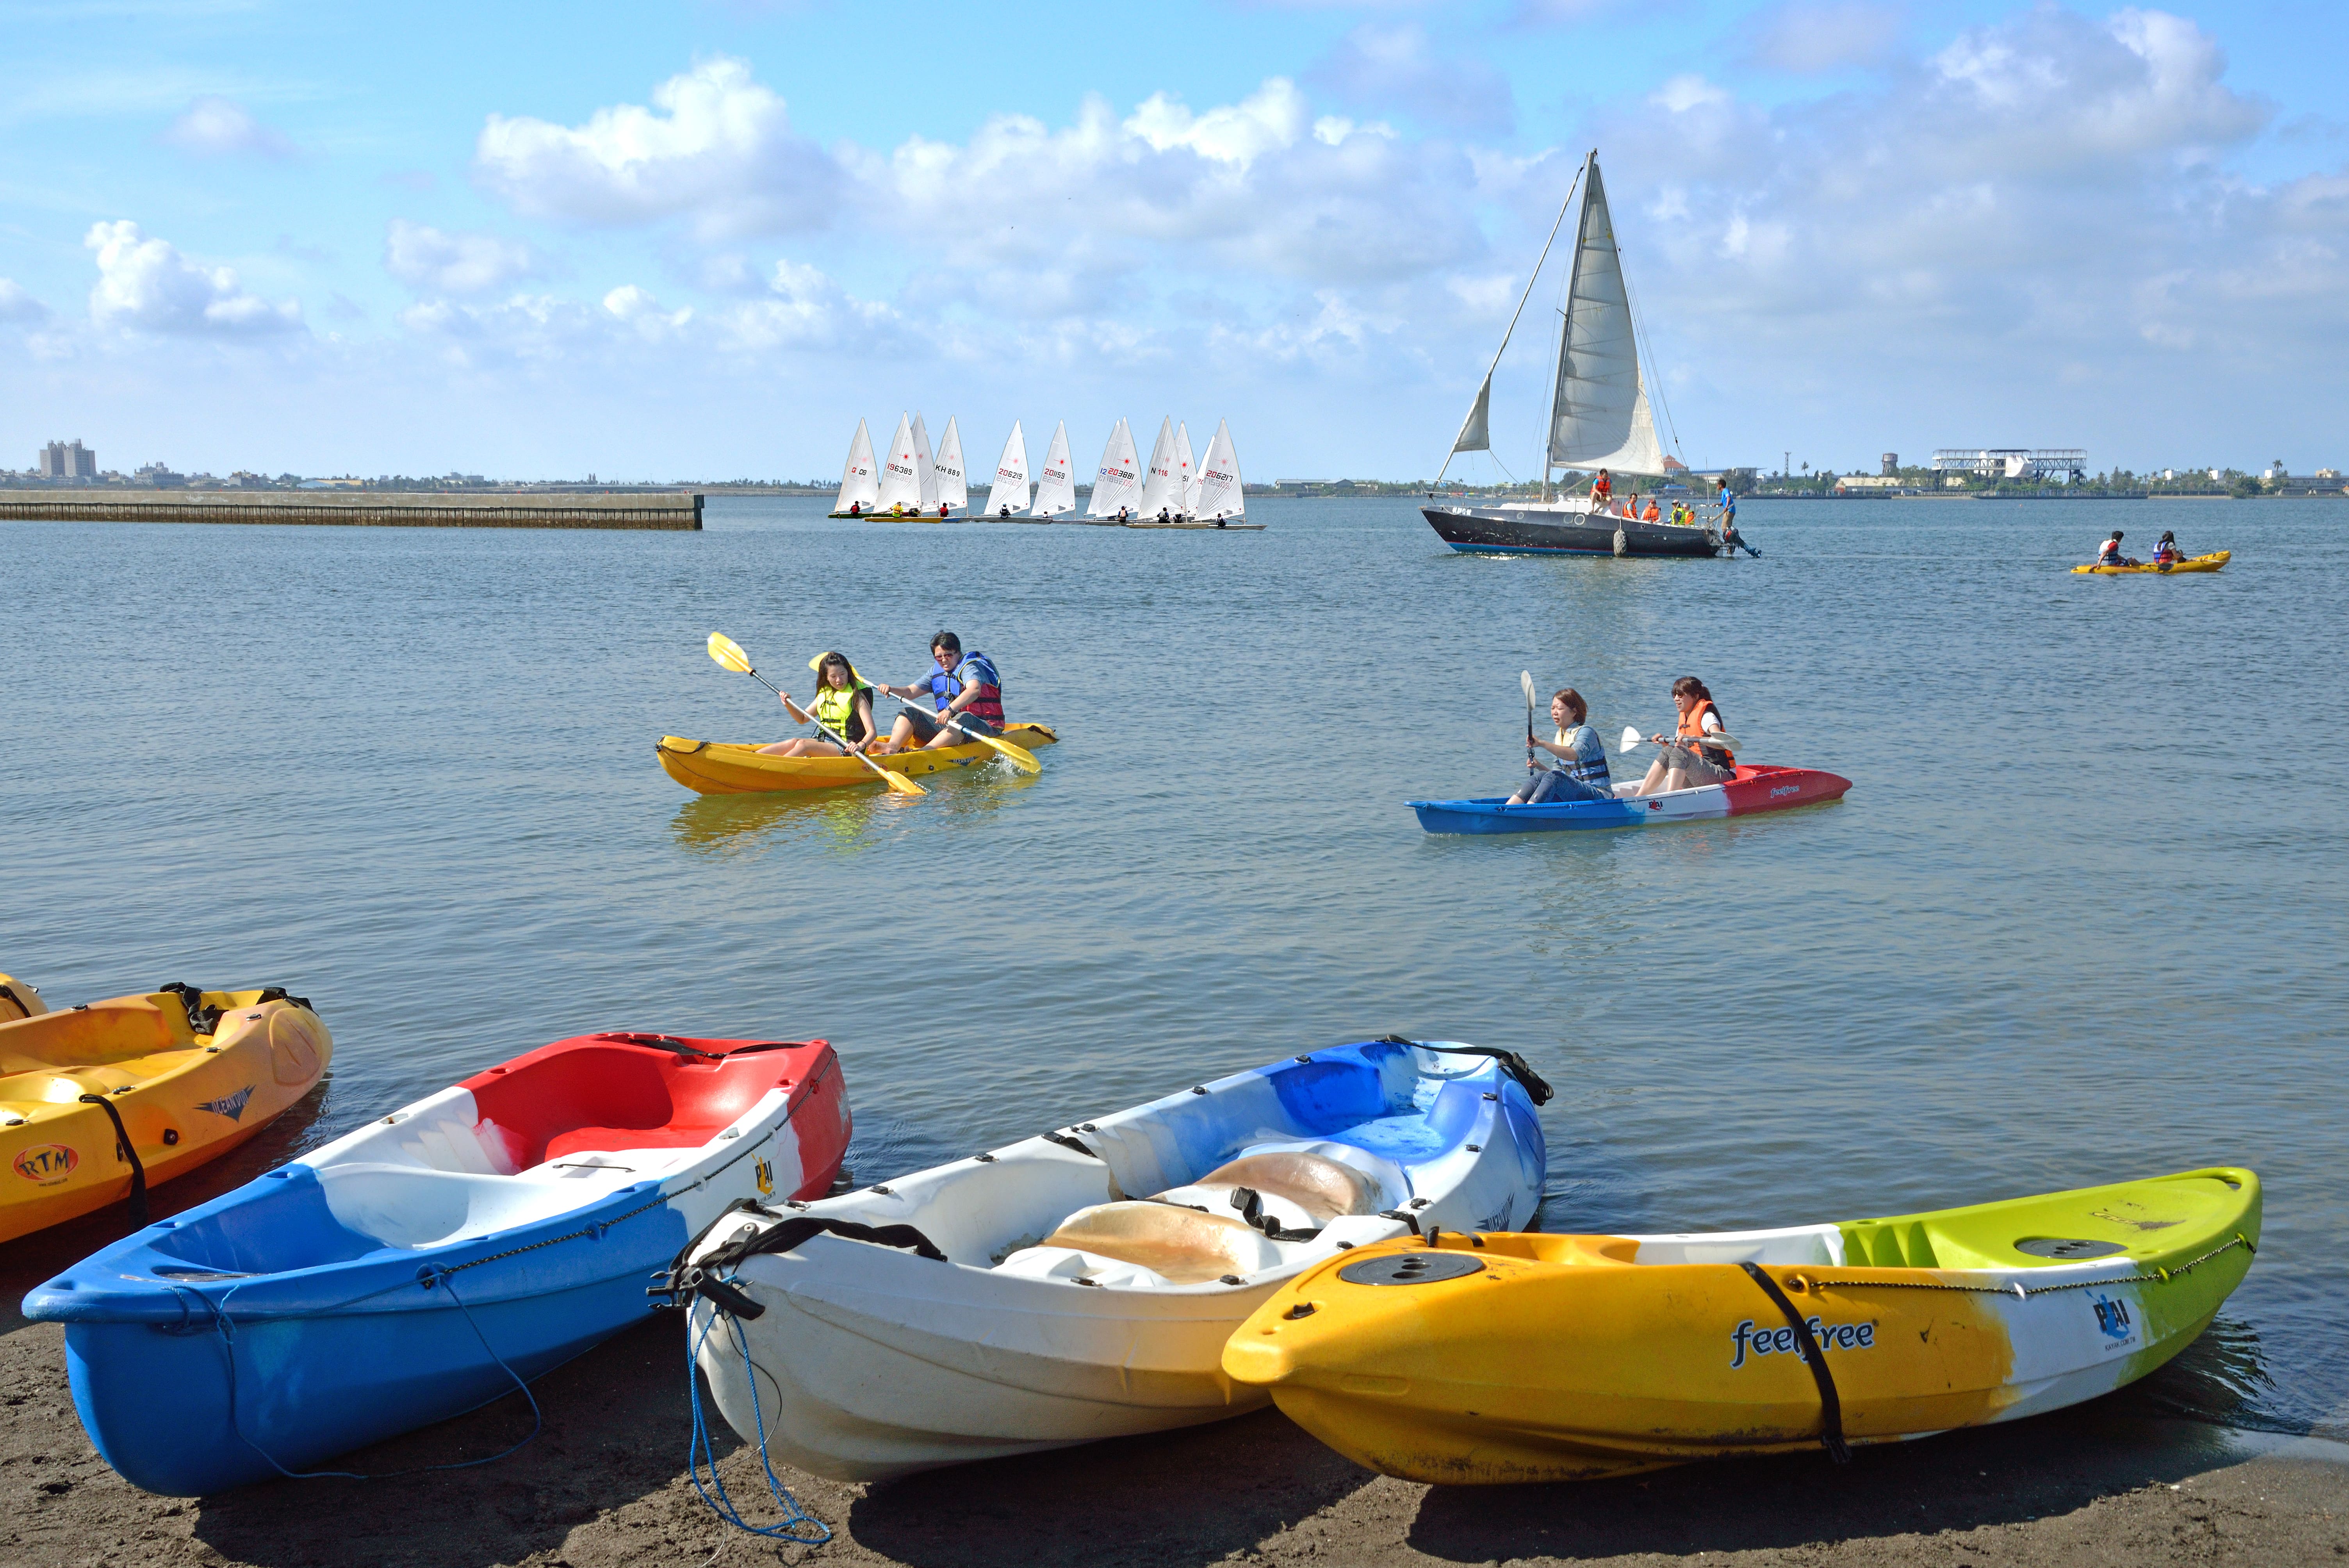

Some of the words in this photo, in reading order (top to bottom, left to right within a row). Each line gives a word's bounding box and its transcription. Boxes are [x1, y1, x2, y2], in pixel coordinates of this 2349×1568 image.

[887, 463, 913, 475] 196389
[935, 464, 946, 473] KH
[948, 468, 960, 477] 889
[998, 468, 1022, 479] 206219
[1044, 468, 1065, 479] 201159
[1108, 468, 1135, 479] 203881
[1206, 470, 1233, 482] 206217
[1770, 785, 1799, 798] feelfree
[211, 1089, 249, 1117] OCEANDUO
[18, 1147, 69, 1176] RTM
[755, 1160, 773, 1188] PAI
[2093, 1299, 2130, 1331] PAI
[2105, 1336, 2136, 1351] KAYAK.COM.TW
